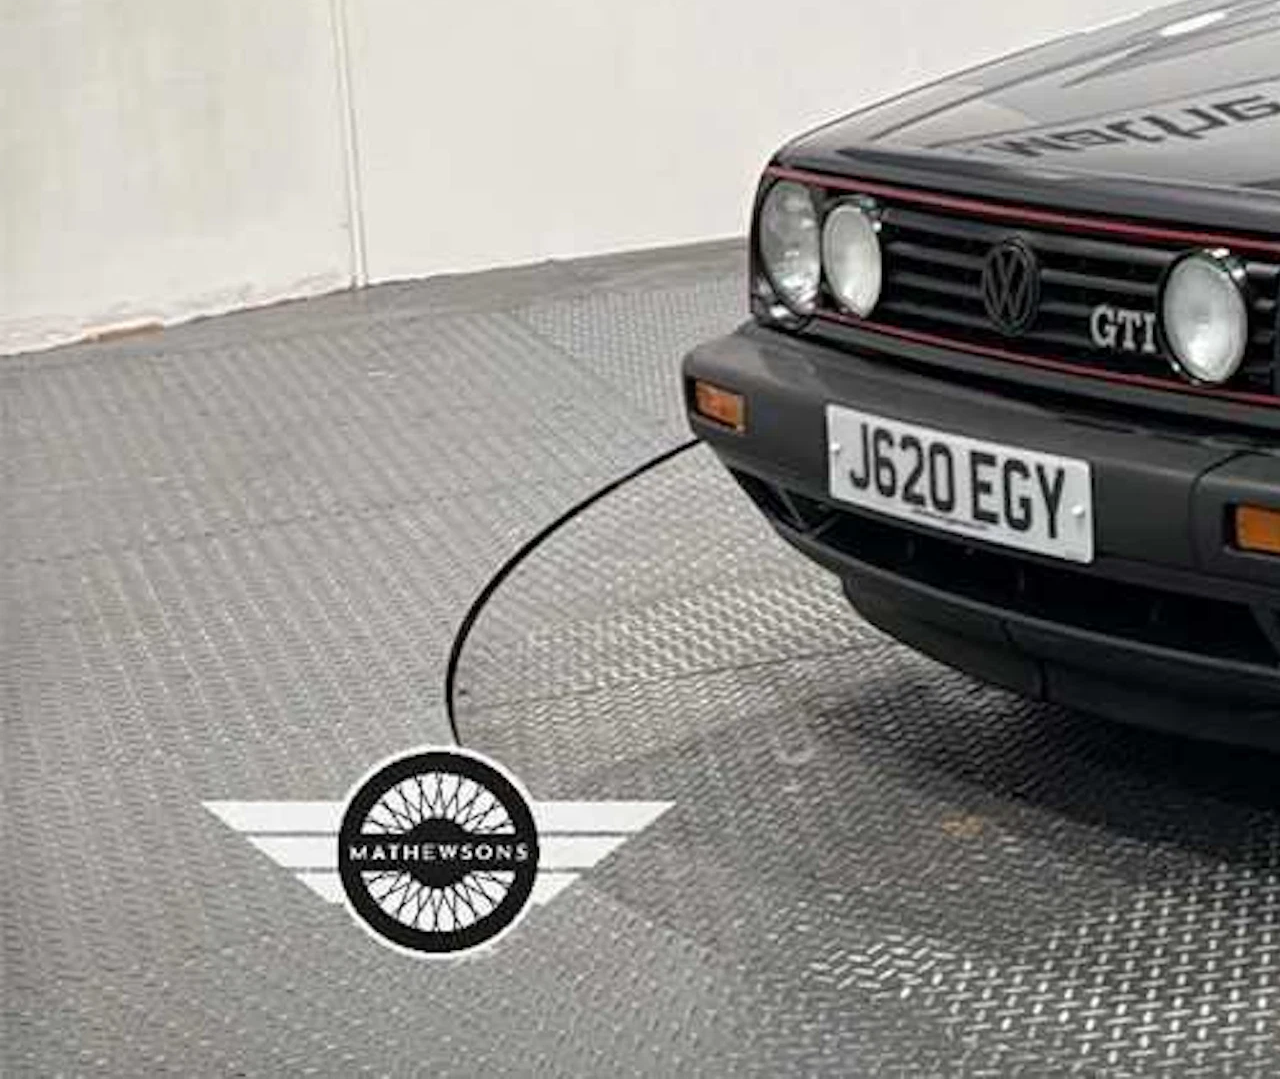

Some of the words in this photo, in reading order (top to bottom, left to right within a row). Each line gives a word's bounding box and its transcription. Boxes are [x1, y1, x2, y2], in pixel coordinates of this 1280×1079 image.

[1090, 304, 1157, 353] GTI
[849, 423, 957, 514] J620
[969, 449, 1066, 540] EGY
